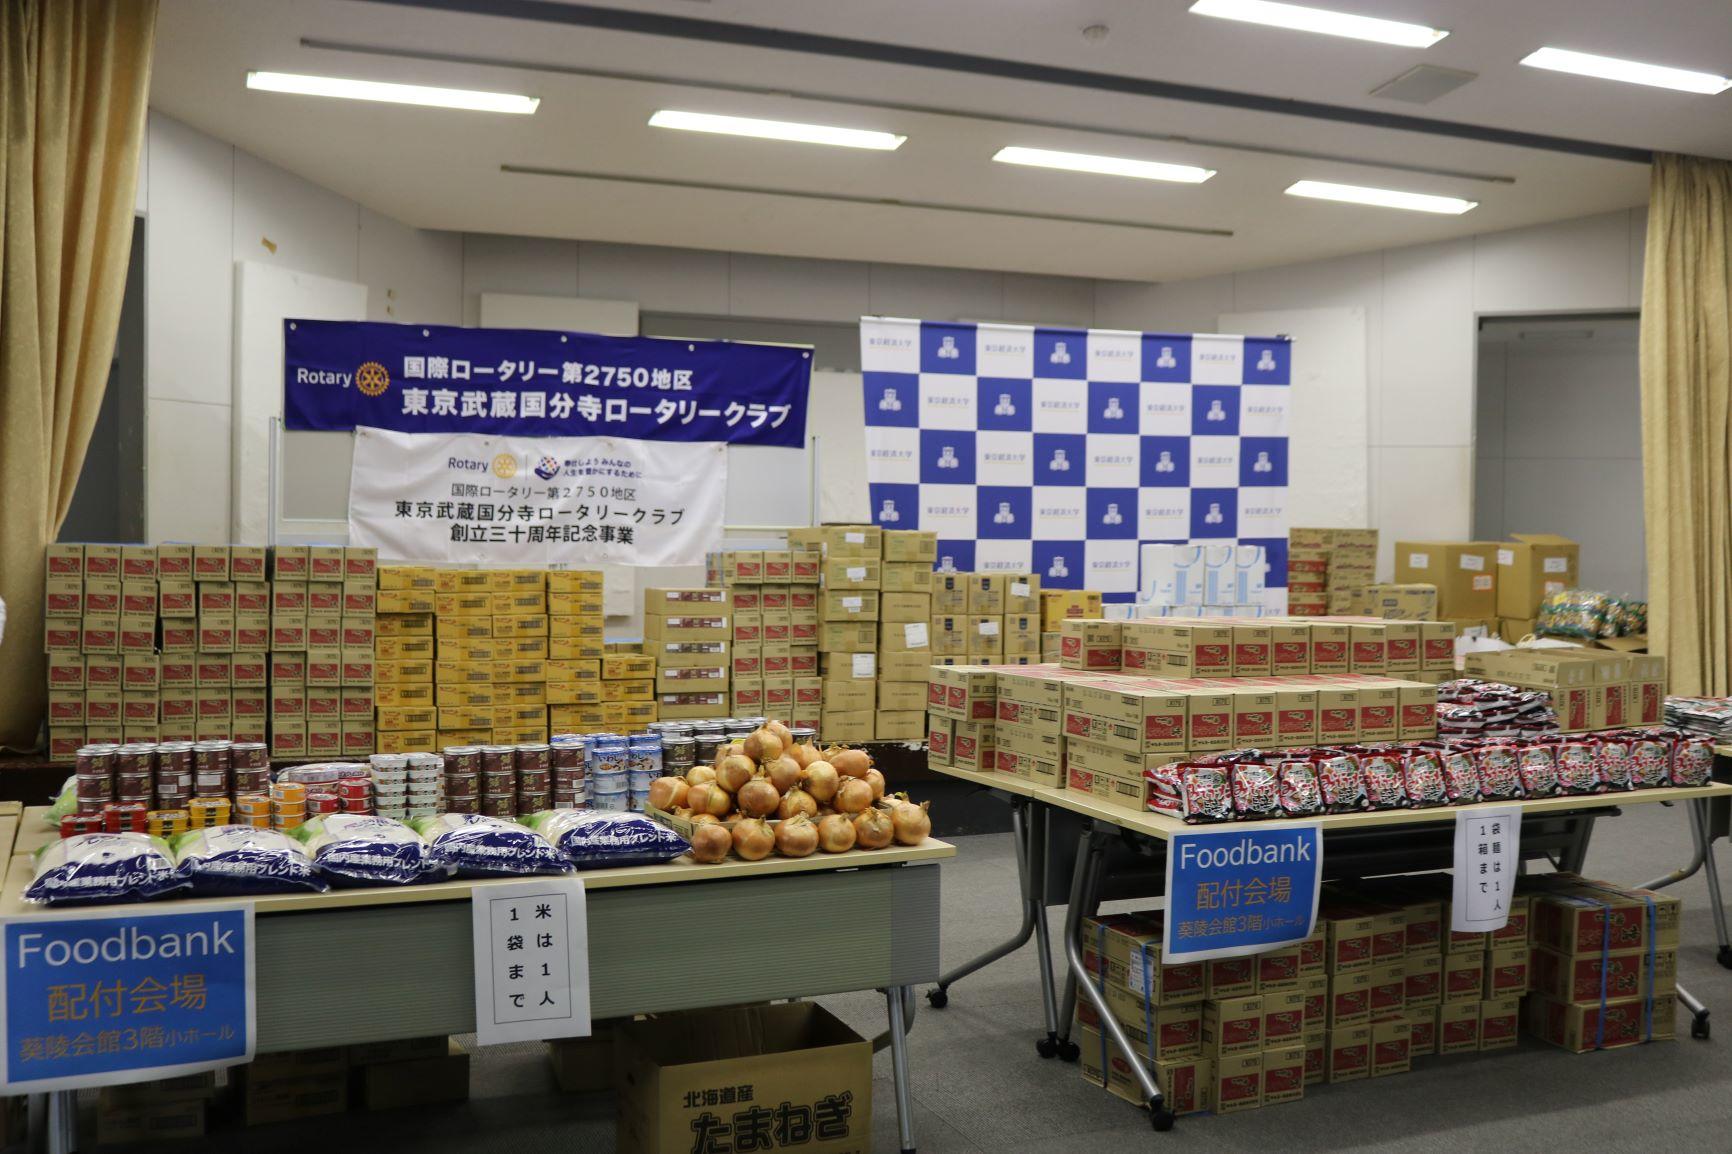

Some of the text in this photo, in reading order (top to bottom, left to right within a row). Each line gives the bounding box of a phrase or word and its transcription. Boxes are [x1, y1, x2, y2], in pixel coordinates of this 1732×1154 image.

[297, 367, 352, 388] Rotary
[403, 356, 693, 391] 国際ロータリー第2750地区
[401, 388, 792, 428] 東京武蔵国分寺ロータリークラブ
[448, 457, 488, 473] Rotary
[395, 500, 686, 526] 東京武蔵国分寺ロータリークラブ
[450, 523, 634, 545] 創立三十周年記念事業
[1180, 836, 1311, 870] Foodbank
[1196, 877, 1292, 911] 配付会場
[18, 921, 235, 969] Foodbank
[507, 907, 525, 1008] 1袋まで
[535, 903, 556, 1006] 米は1人
[46, 972, 208, 1022] 配付会場
[683, 1084, 754, 1109] 北海道産
[690, 1090, 853, 1154] たまねぎ
